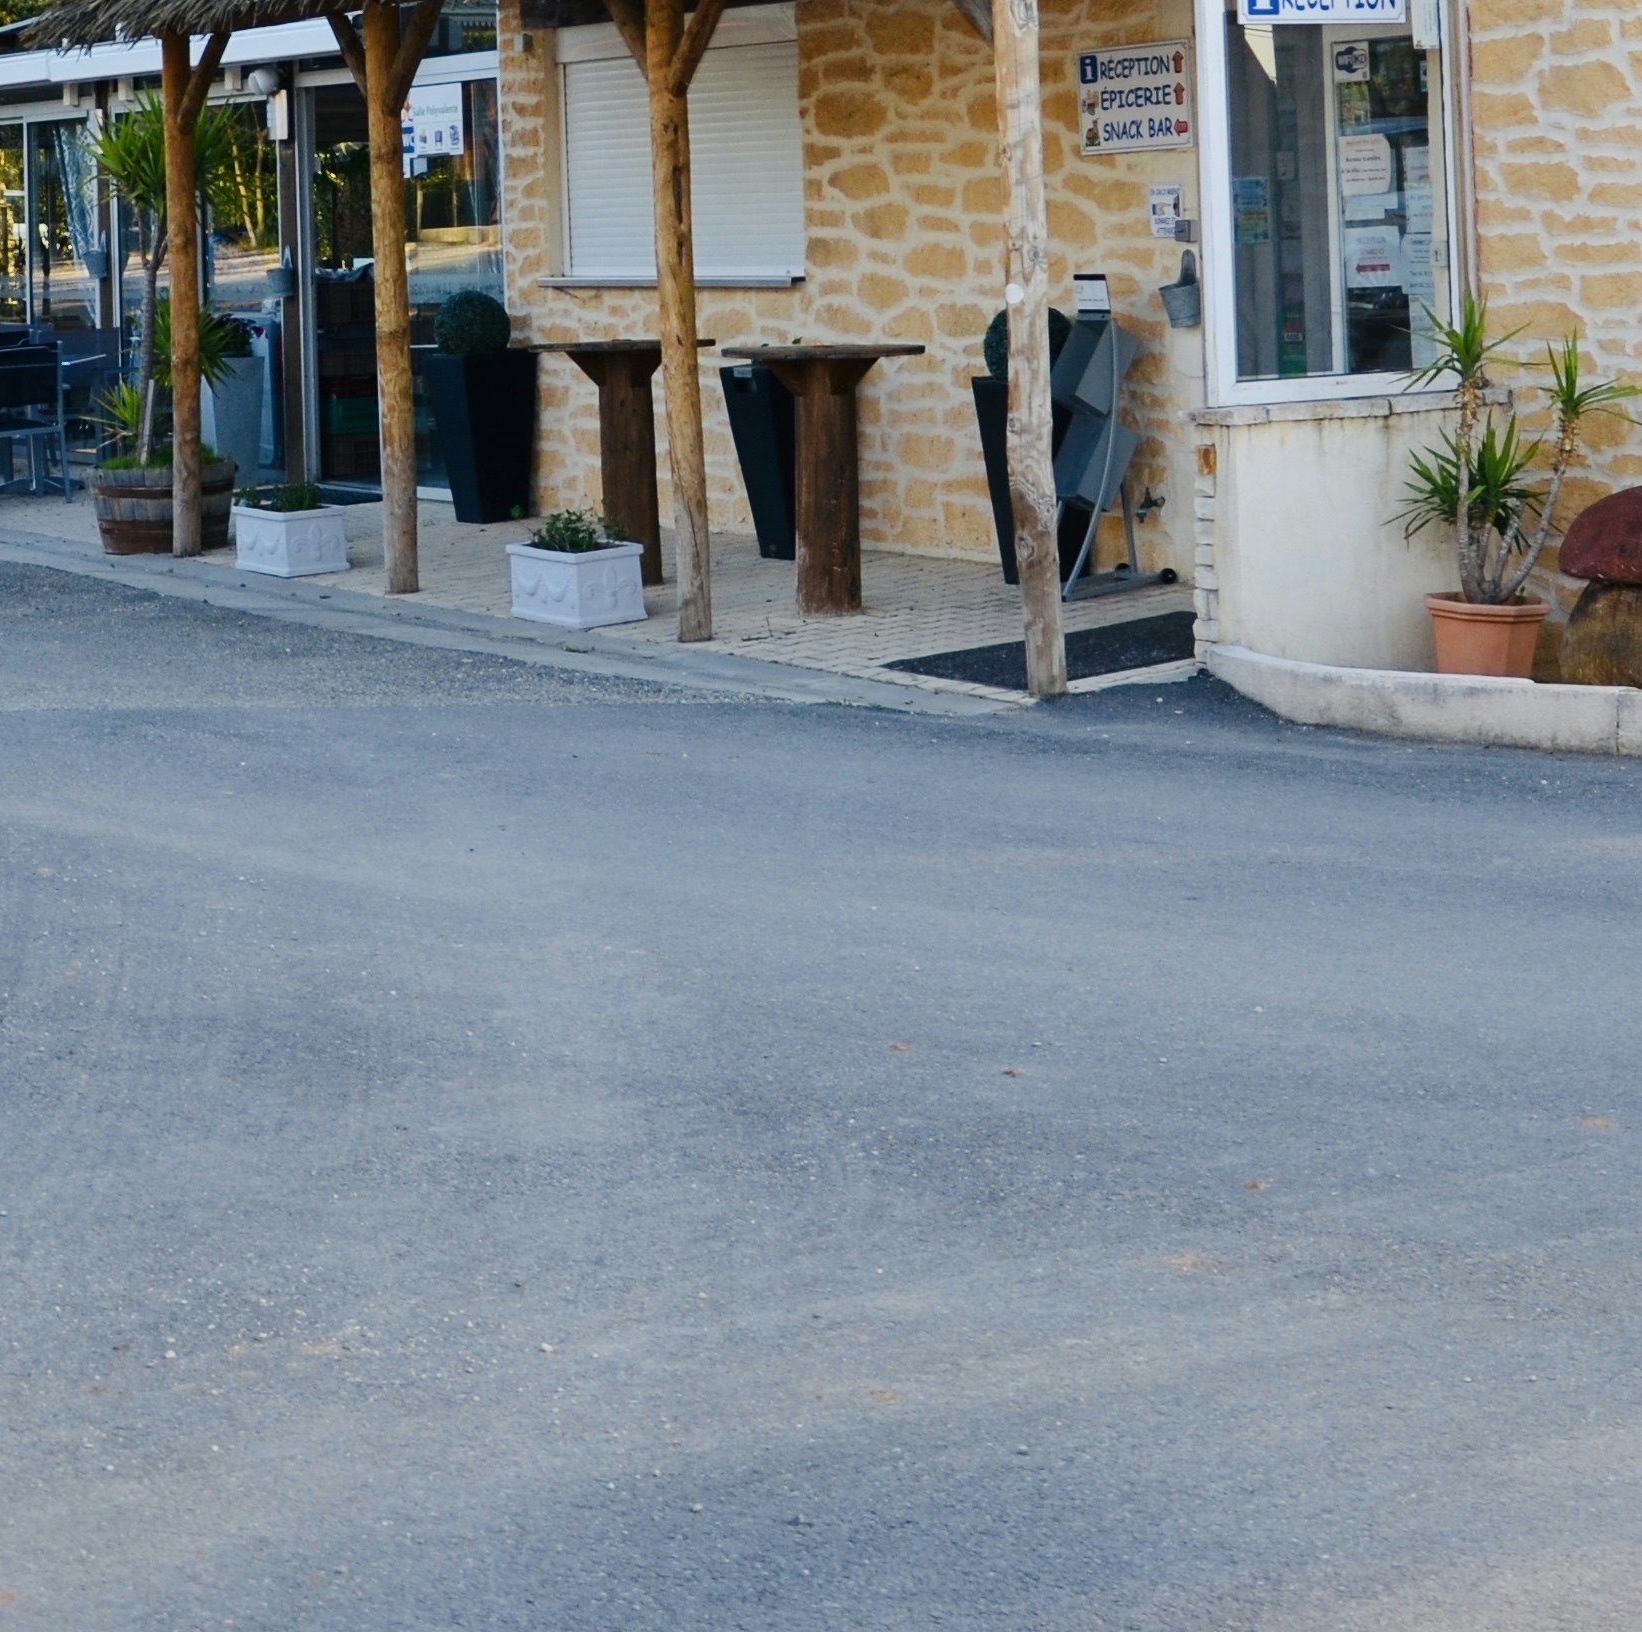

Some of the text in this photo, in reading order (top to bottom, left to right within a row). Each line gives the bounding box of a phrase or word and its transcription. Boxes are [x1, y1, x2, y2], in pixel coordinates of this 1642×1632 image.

[1100, 54, 1171, 80] RÉCEPTION
[1100, 84, 1172, 111] ÉPICERIE
[1102, 116, 1174, 142] SNACK BAR
